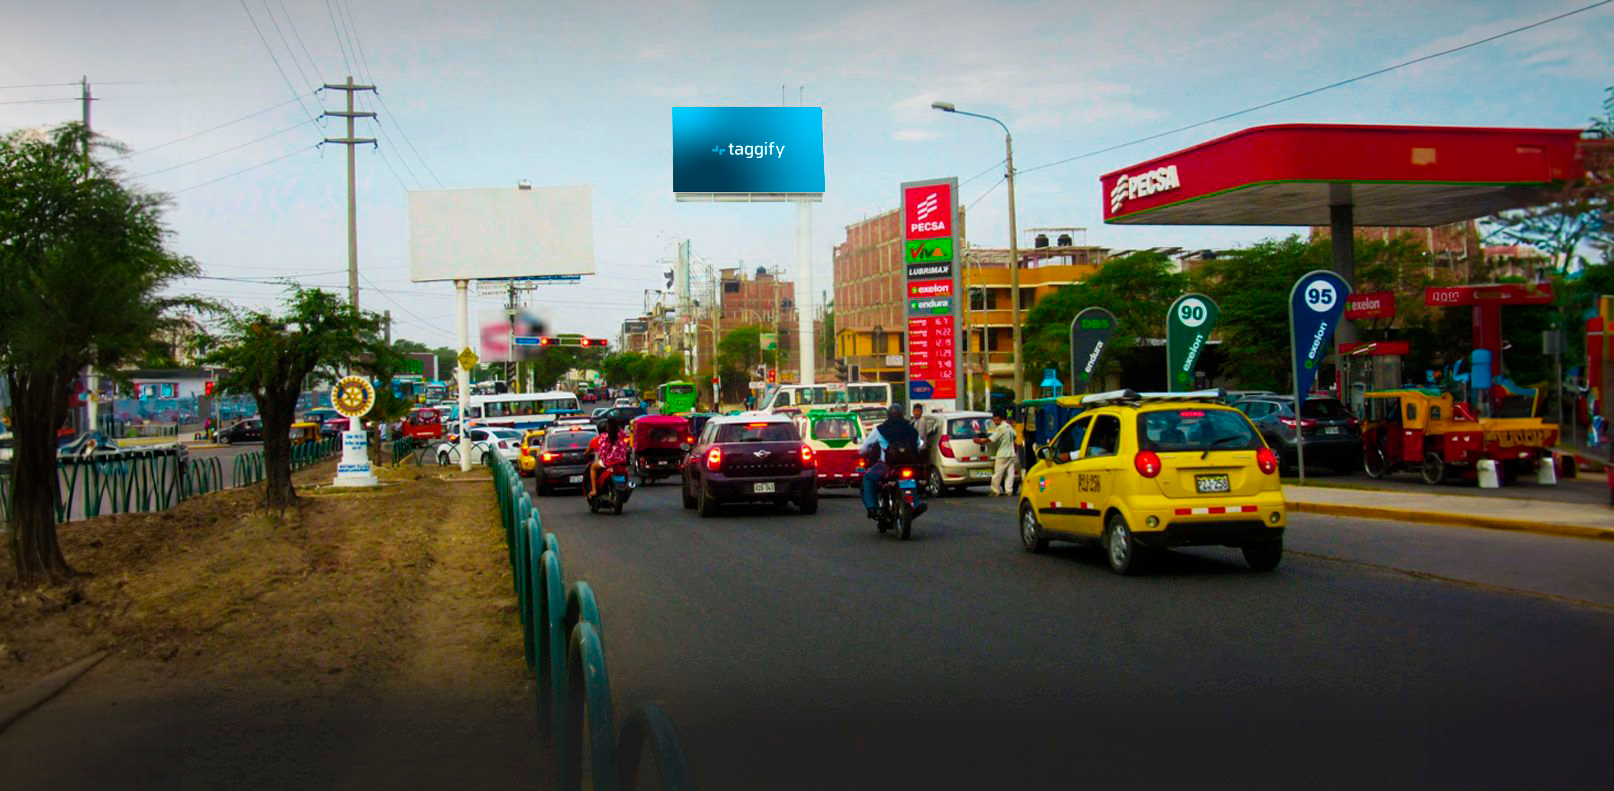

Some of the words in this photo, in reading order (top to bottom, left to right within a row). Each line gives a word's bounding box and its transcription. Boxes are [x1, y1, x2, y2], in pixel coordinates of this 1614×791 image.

[728, 141, 785, 158] taggify
[1128, 165, 1180, 200] PECSA
[911, 221, 945, 232] PECSA
[909, 266, 949, 275] LUBRIMAX
[918, 284, 949, 293] exelon
[1308, 288, 1332, 305] 95
[918, 299, 949, 308] endura
[1351, 298, 1380, 311] exelon
[1181, 305, 1203, 321] 90
[1308, 321, 1328, 359] exelon
[1085, 340, 1104, 373] endura
[1183, 333, 1203, 372] exelon
